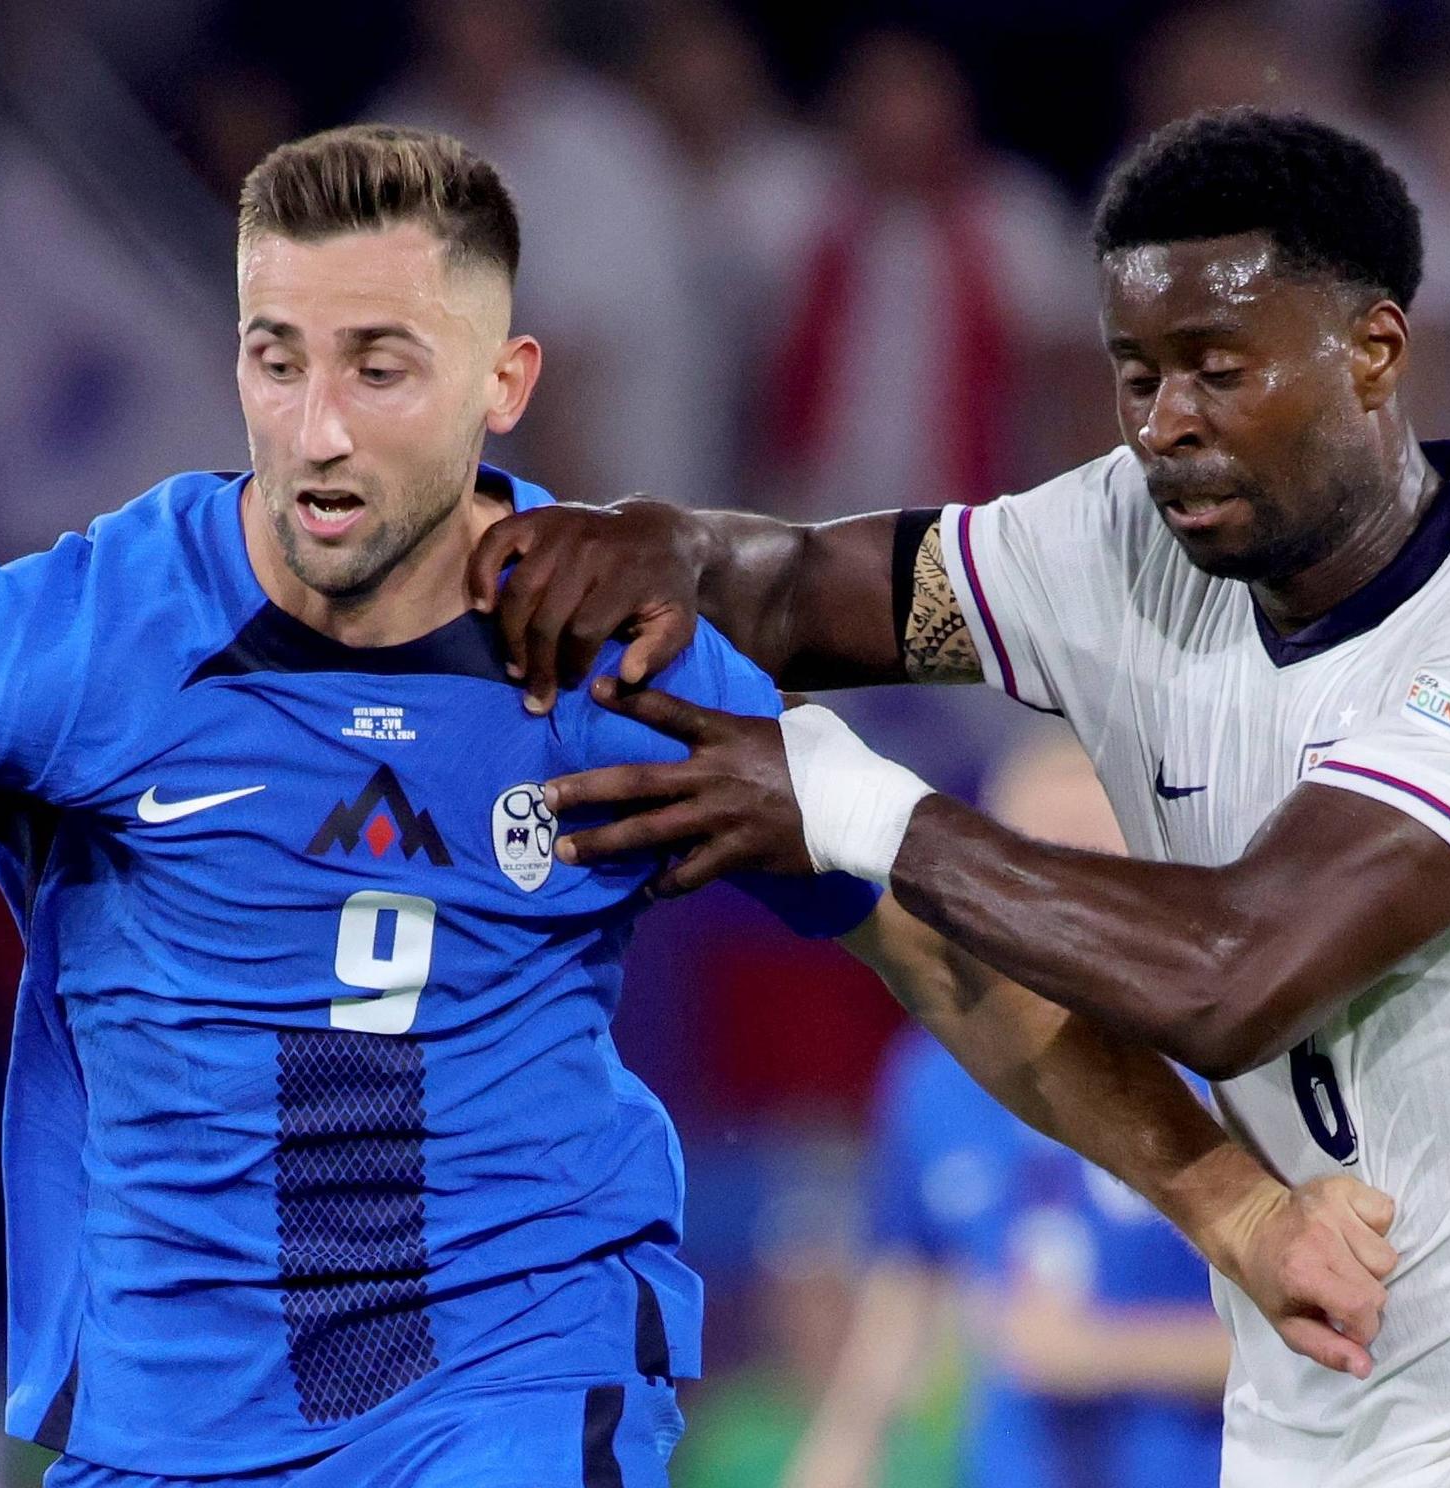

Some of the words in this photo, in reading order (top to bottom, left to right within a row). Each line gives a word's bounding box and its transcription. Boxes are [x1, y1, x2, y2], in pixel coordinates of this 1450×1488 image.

[1414, 674, 1439, 689] UEFA
[354, 718, 373, 729] ENG
[382, 718, 401, 730] SVN
[330, 889, 437, 1035] 9
[1289, 1033, 1359, 1167] 6
